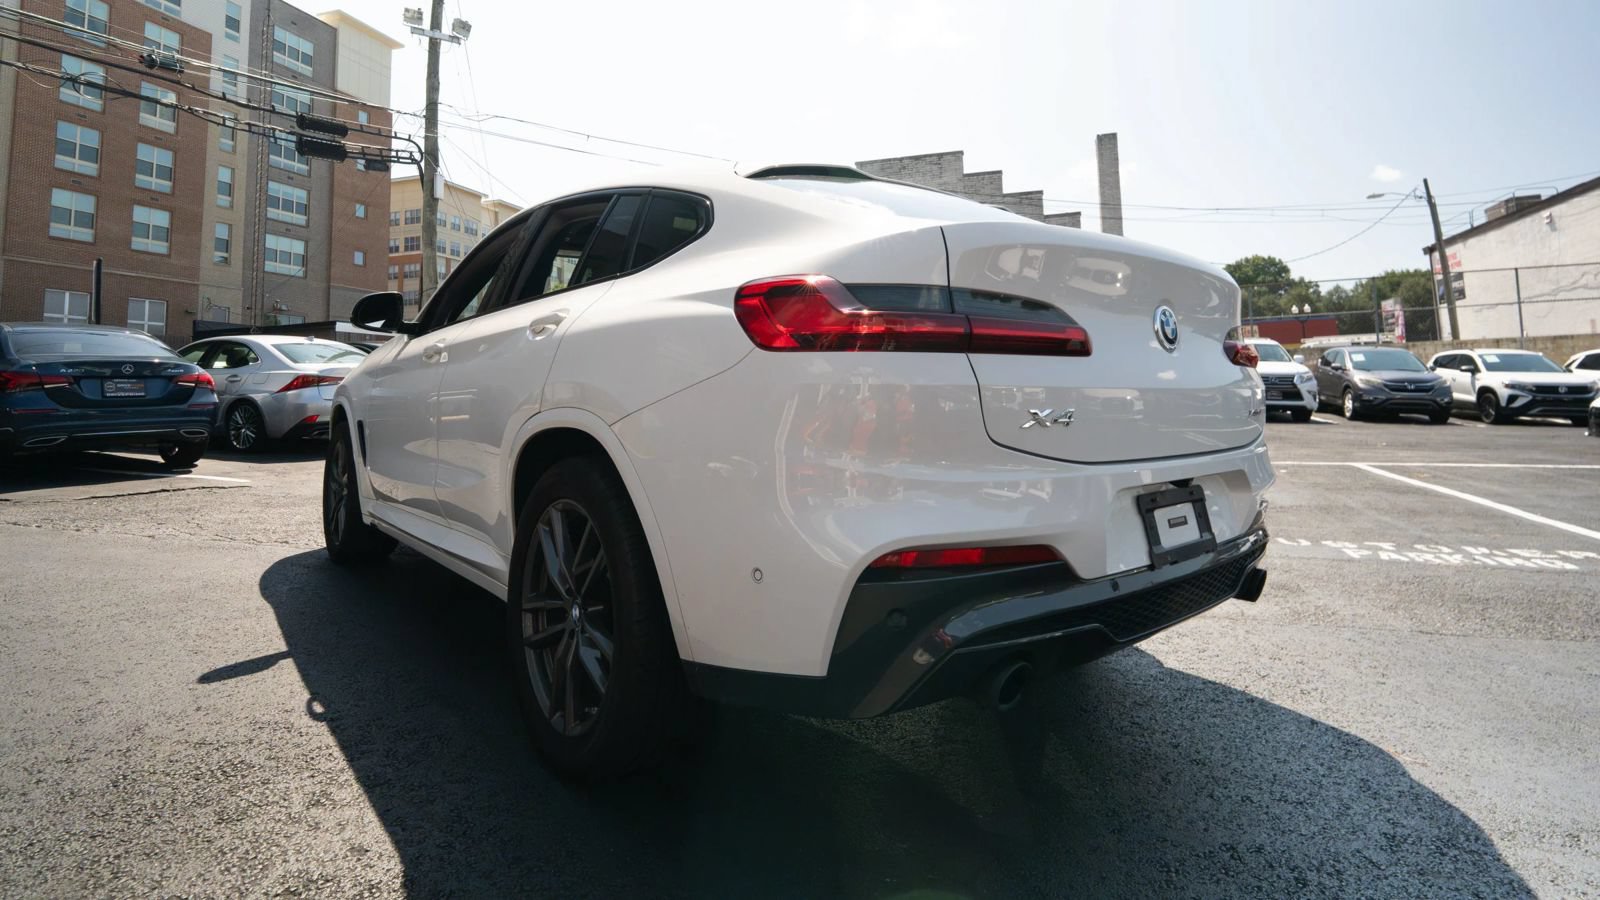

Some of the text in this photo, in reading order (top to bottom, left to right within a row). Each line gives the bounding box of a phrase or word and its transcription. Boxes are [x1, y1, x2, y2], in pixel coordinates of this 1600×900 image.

[1019, 408, 1075, 429] X4
[1274, 537, 1600, 560] USTOMER
[1340, 547, 1580, 570] PARKING
